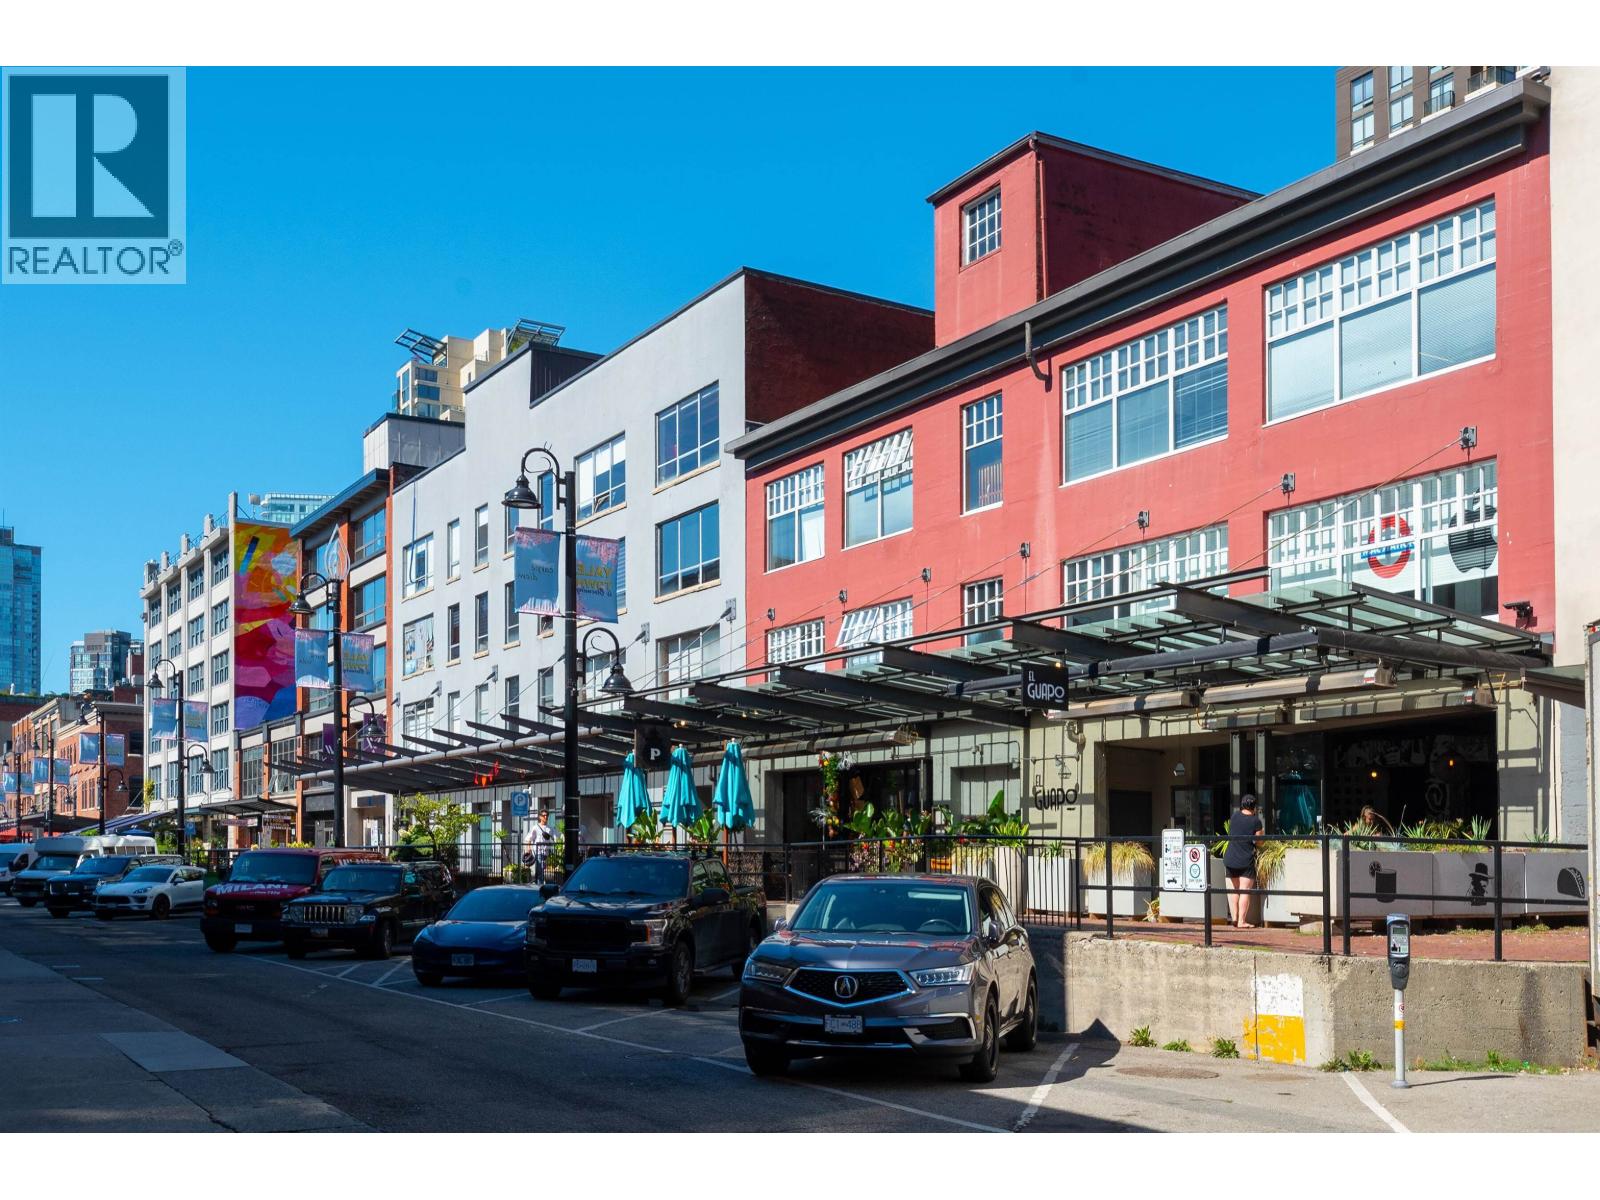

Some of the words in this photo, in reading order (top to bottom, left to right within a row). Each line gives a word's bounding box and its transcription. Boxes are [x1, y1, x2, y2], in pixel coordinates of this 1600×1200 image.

[1028, 670, 1036, 682] EL
[1027, 683, 1065, 701] GUAPO
[650, 747, 661, 761] P
[1035, 774, 1043, 788] EL
[1034, 788, 1078, 811] GUAPO
[215, 883, 289, 896] MILANI
